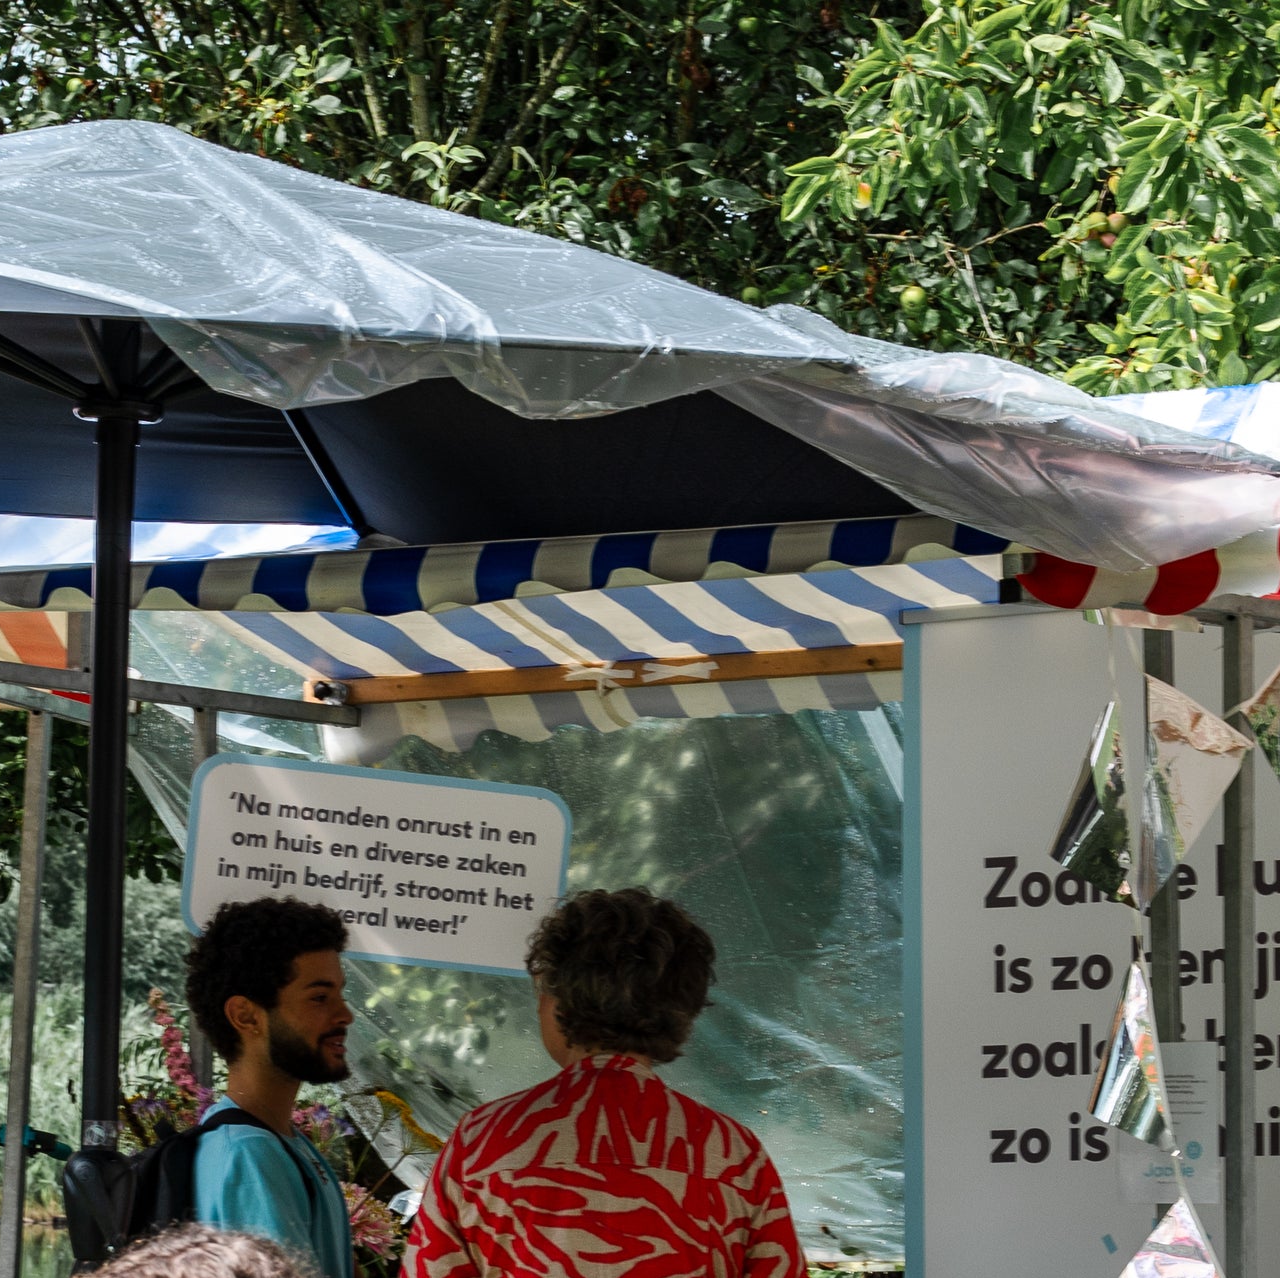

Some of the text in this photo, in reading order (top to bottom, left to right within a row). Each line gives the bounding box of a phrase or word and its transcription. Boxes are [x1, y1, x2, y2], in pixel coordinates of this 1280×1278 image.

[278, 801, 390, 830] maanden
[397, 816, 473, 840] onrust
[479, 821, 502, 842] in
[508, 828, 537, 846] en
[231, 828, 527, 877] om huis en diverse zaken
[217, 857, 534, 912] in mijn bedrijf, stroomt het
[984, 855, 1115, 908] Zoa
[338, 907, 388, 927] eral
[994, 944, 1034, 994] is
[1051, 954, 1114, 991] zo
[990, 1128, 1051, 1164] zo
[1070, 1111, 1109, 1161] is
